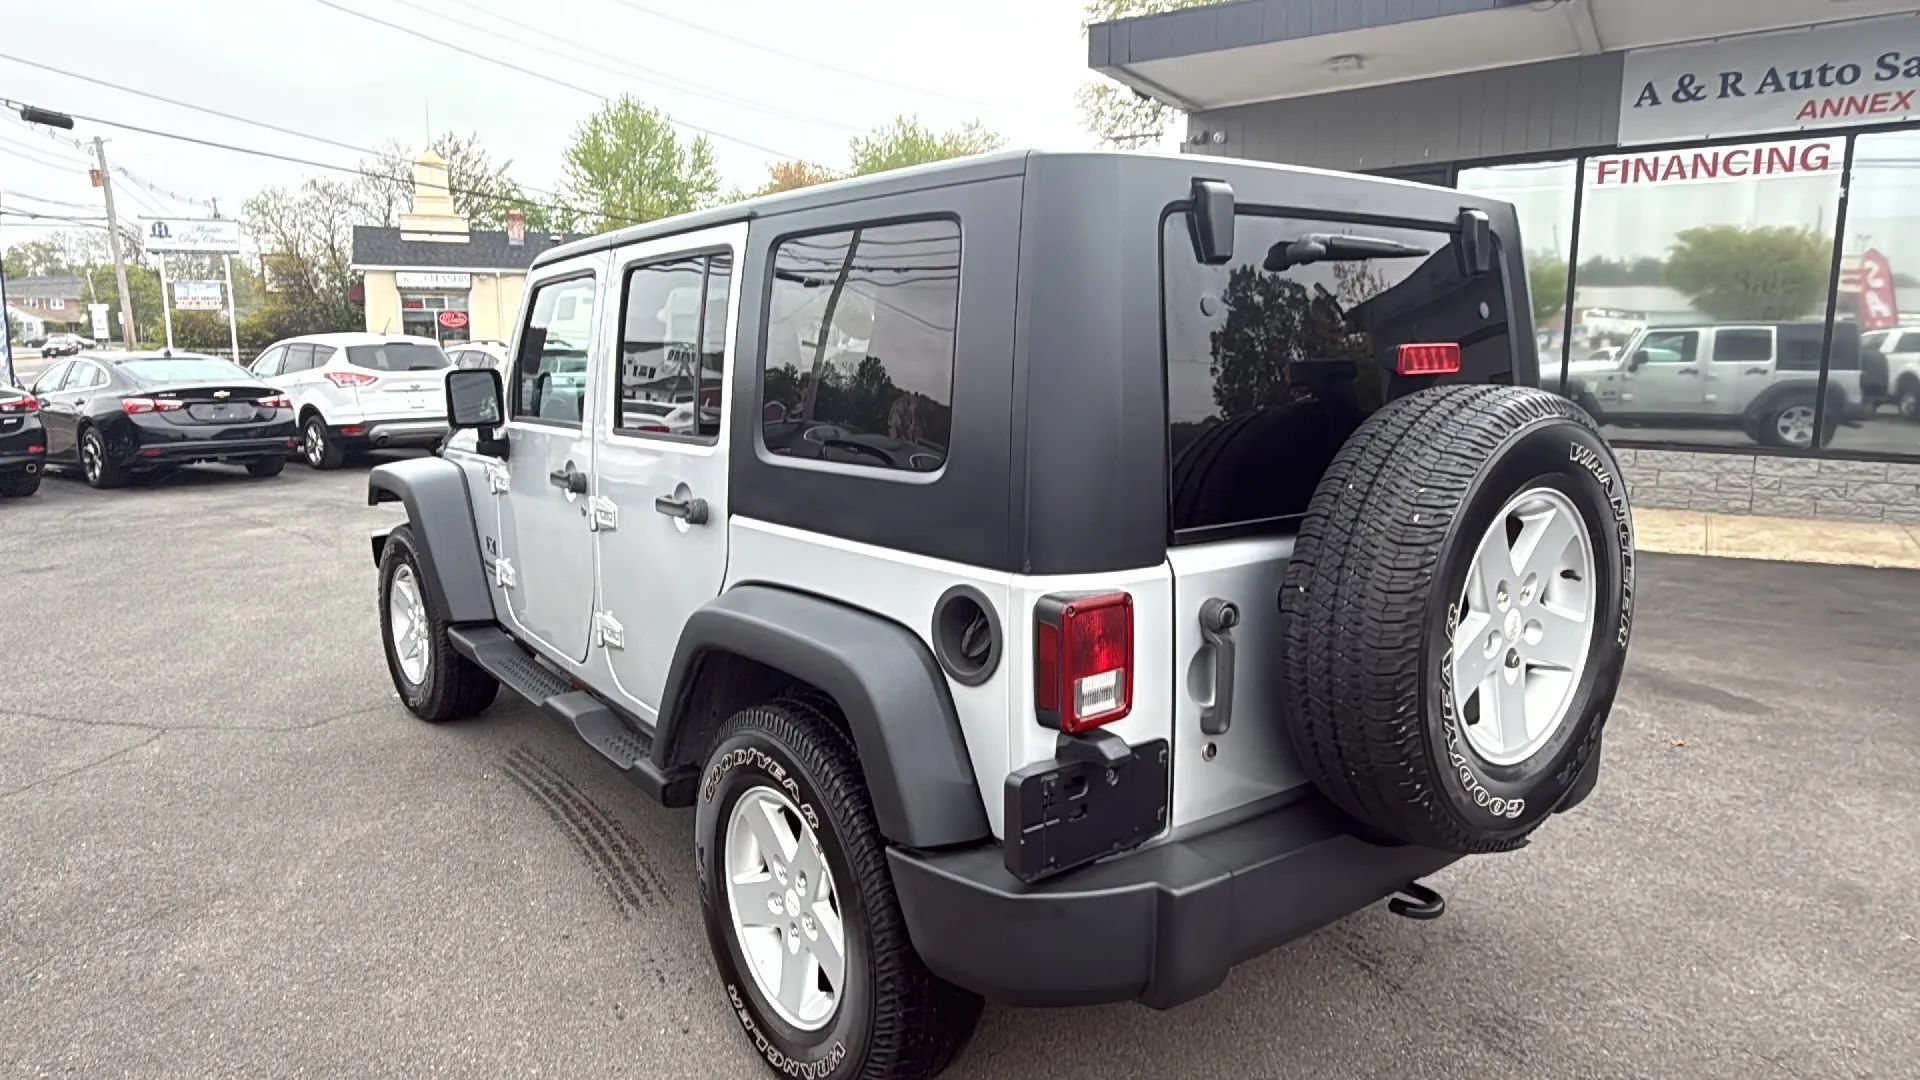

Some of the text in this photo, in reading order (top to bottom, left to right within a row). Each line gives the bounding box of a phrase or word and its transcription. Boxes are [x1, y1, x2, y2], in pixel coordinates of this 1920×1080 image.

[1633, 81, 1662, 108] A
[1671, 73, 1707, 102] &
[1717, 71, 1747, 99] R
[1754, 62, 1862, 95] Auto
[1795, 89, 1917, 120] ANNEX
[1597, 143, 1832, 185] FINANCING
[1568, 440, 1631, 648] WRANGLER
[1439, 602, 1526, 819] GOODYEAR
[704, 747, 819, 829] GOODYEAR
[727, 983, 846, 1080] WRANGLER
